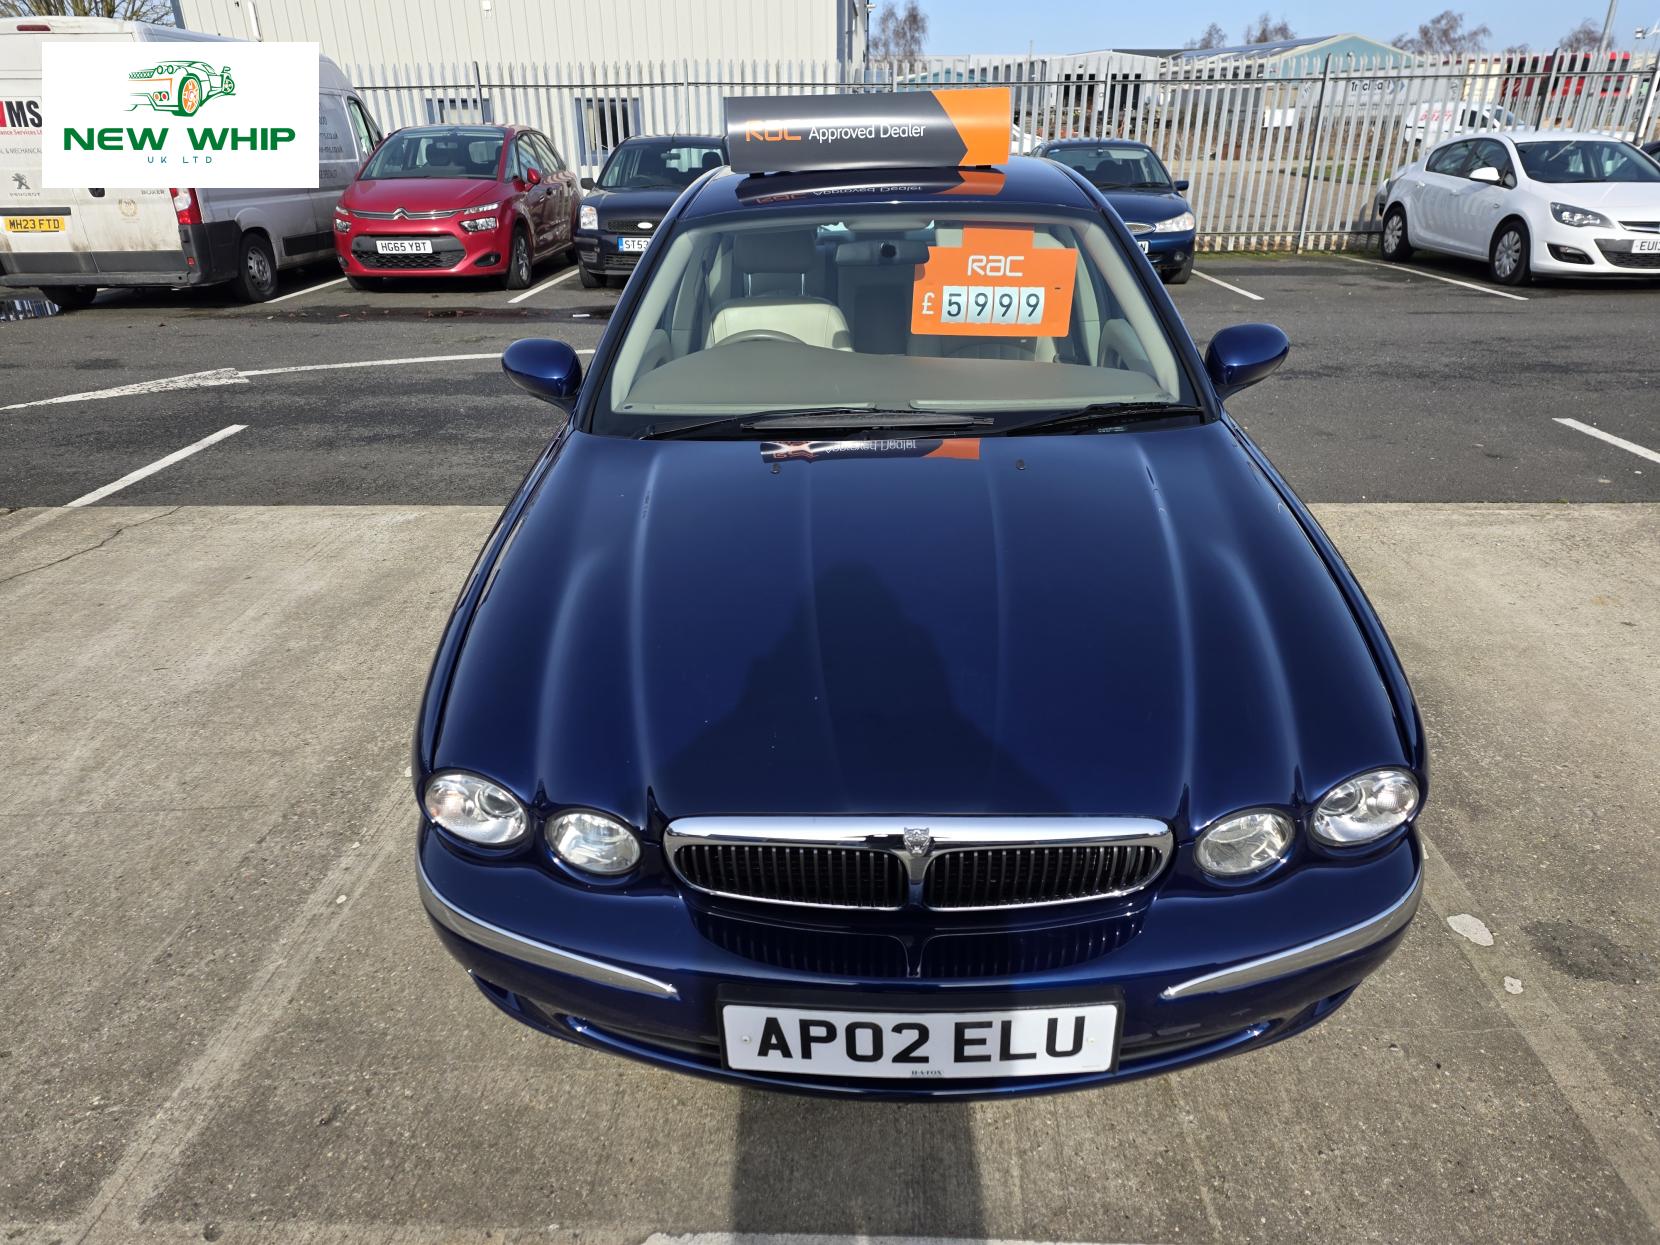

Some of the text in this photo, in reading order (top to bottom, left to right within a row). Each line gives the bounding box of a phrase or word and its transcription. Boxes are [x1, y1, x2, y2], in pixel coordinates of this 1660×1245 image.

[808, 125, 875, 144] Approved
[880, 122, 926, 139] Dealer
[9, 218, 60, 229] MH23 FTD
[380, 242, 427, 252] HG65 YBT
[921, 292, 1040, 318] £ 5999
[757, 1015, 1085, 1064] AP02 ELU
